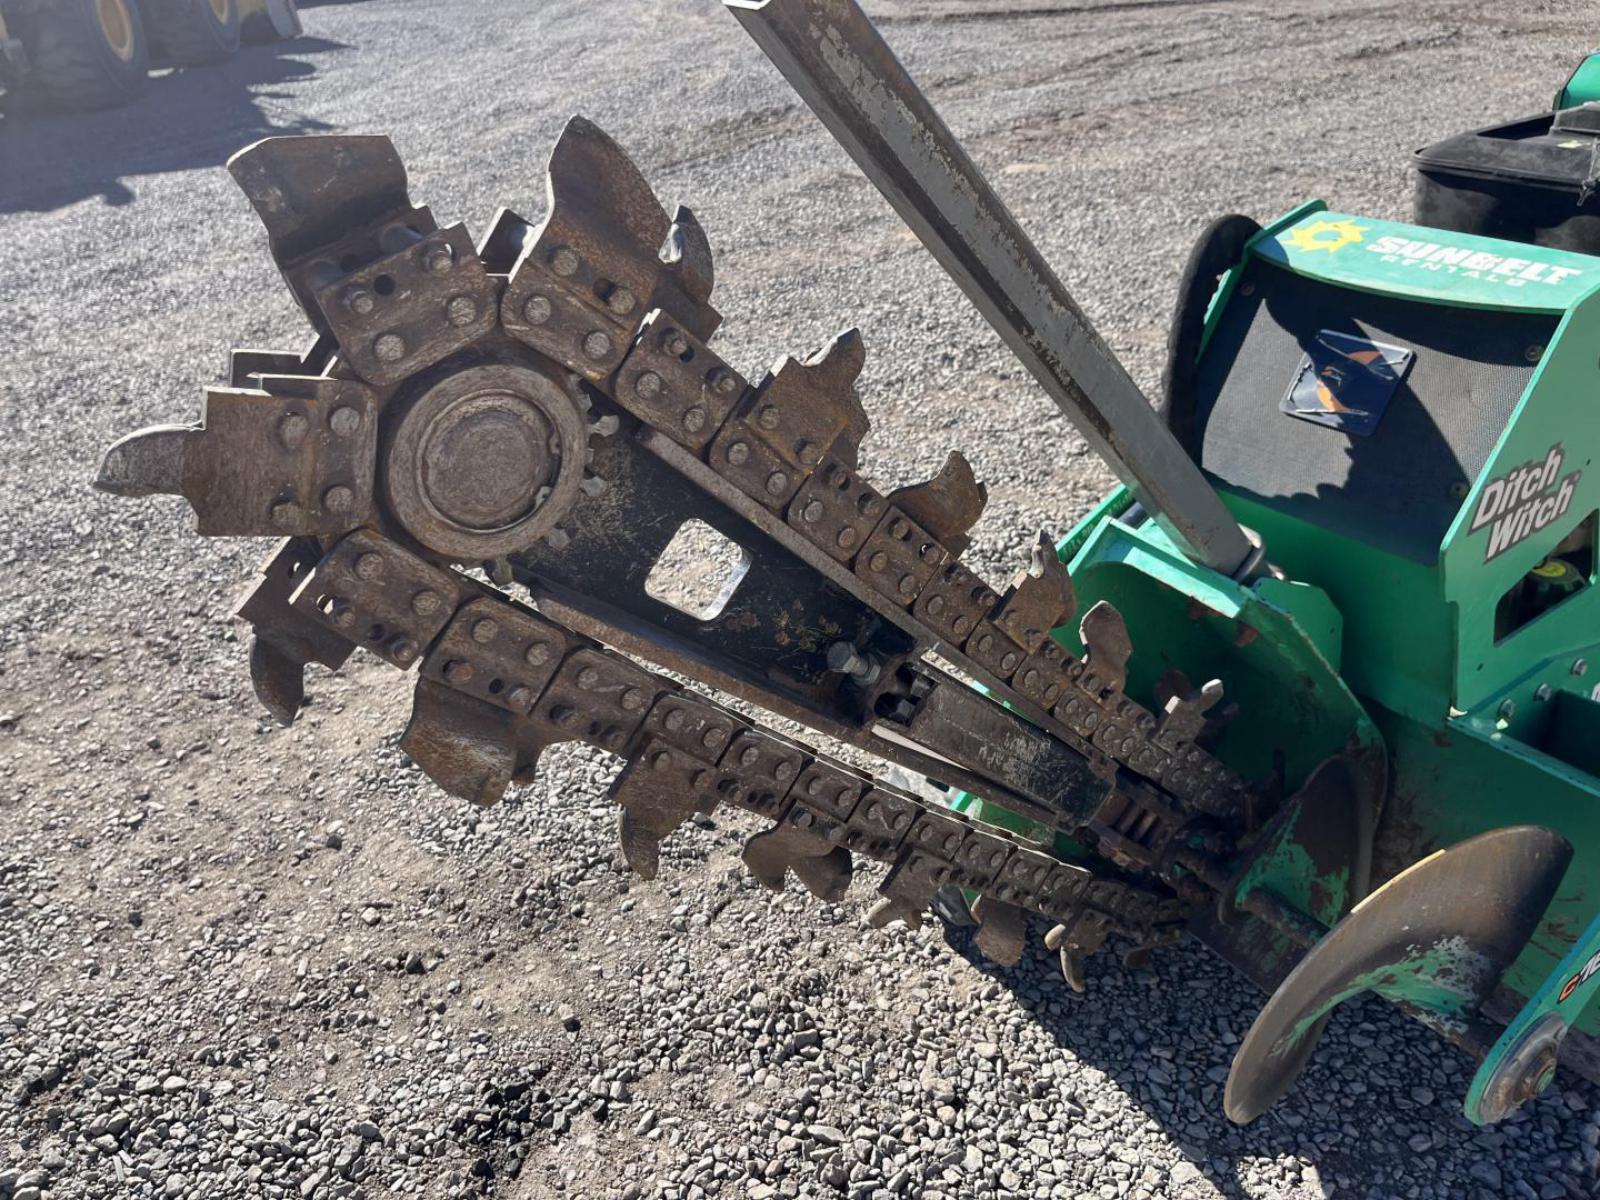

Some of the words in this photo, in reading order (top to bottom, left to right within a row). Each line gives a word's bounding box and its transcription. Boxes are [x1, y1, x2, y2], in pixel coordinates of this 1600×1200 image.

[1366, 236, 1582, 285] SUNBELT
[1381, 254, 1526, 286] RENTALS
[1470, 447, 1562, 531] Ditch
[1486, 477, 1576, 560] Witch
